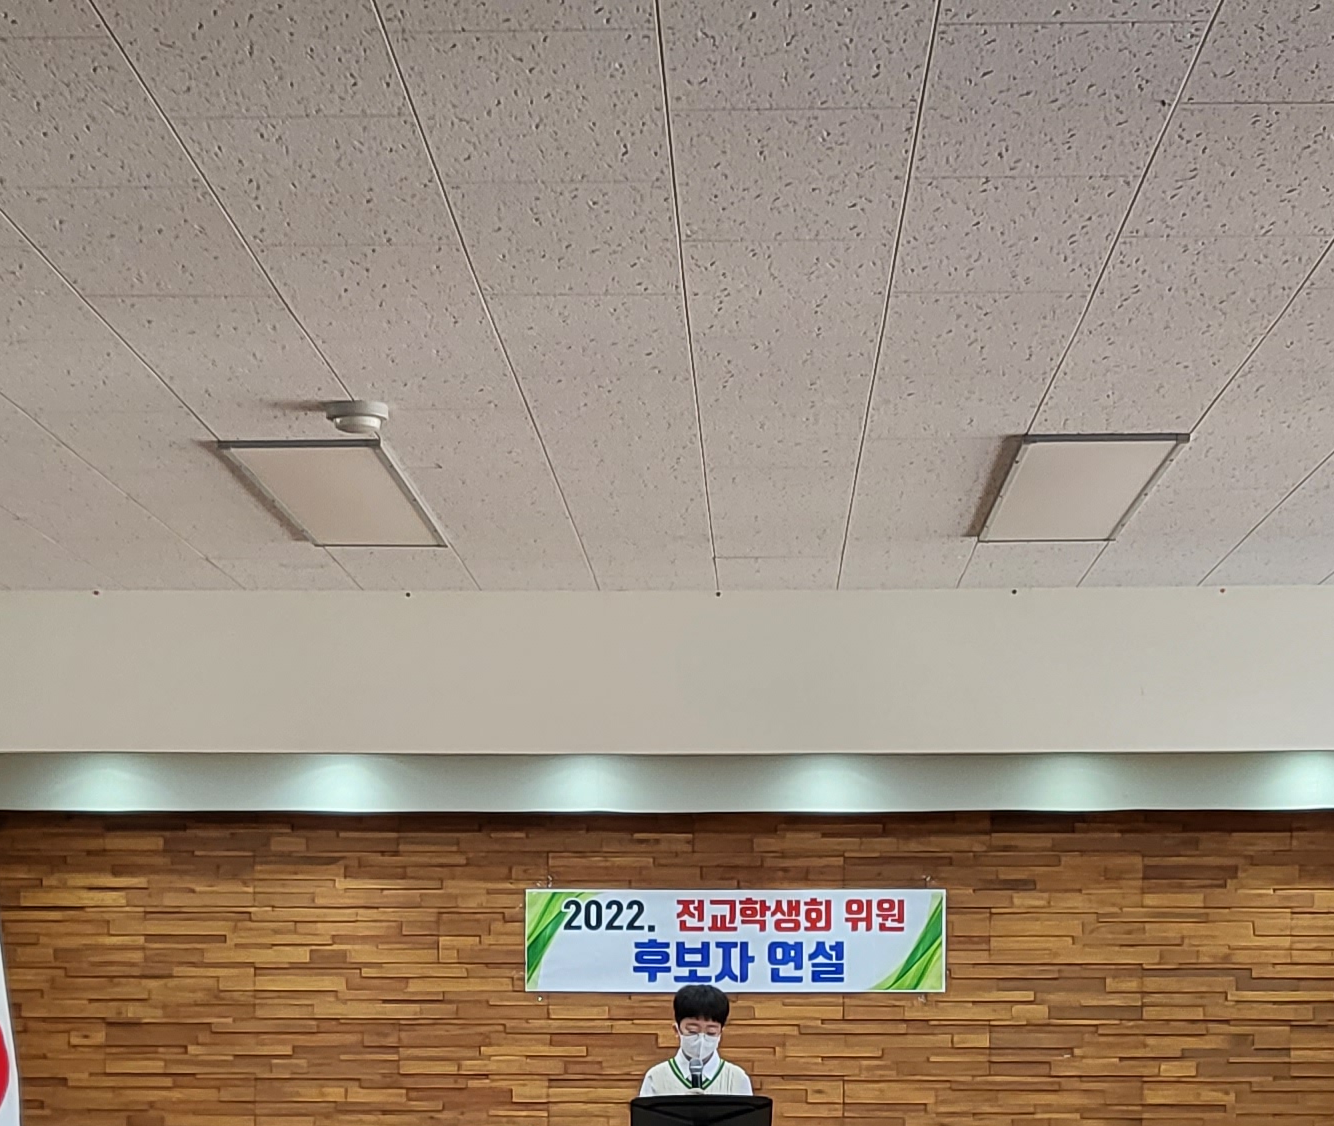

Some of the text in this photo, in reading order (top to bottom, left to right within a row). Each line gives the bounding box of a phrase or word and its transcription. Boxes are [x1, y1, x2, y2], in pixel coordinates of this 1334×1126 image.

[562, 897, 906, 933] 2022. 전교학생회 위원
[632, 938, 845, 984] 후보자 연설
